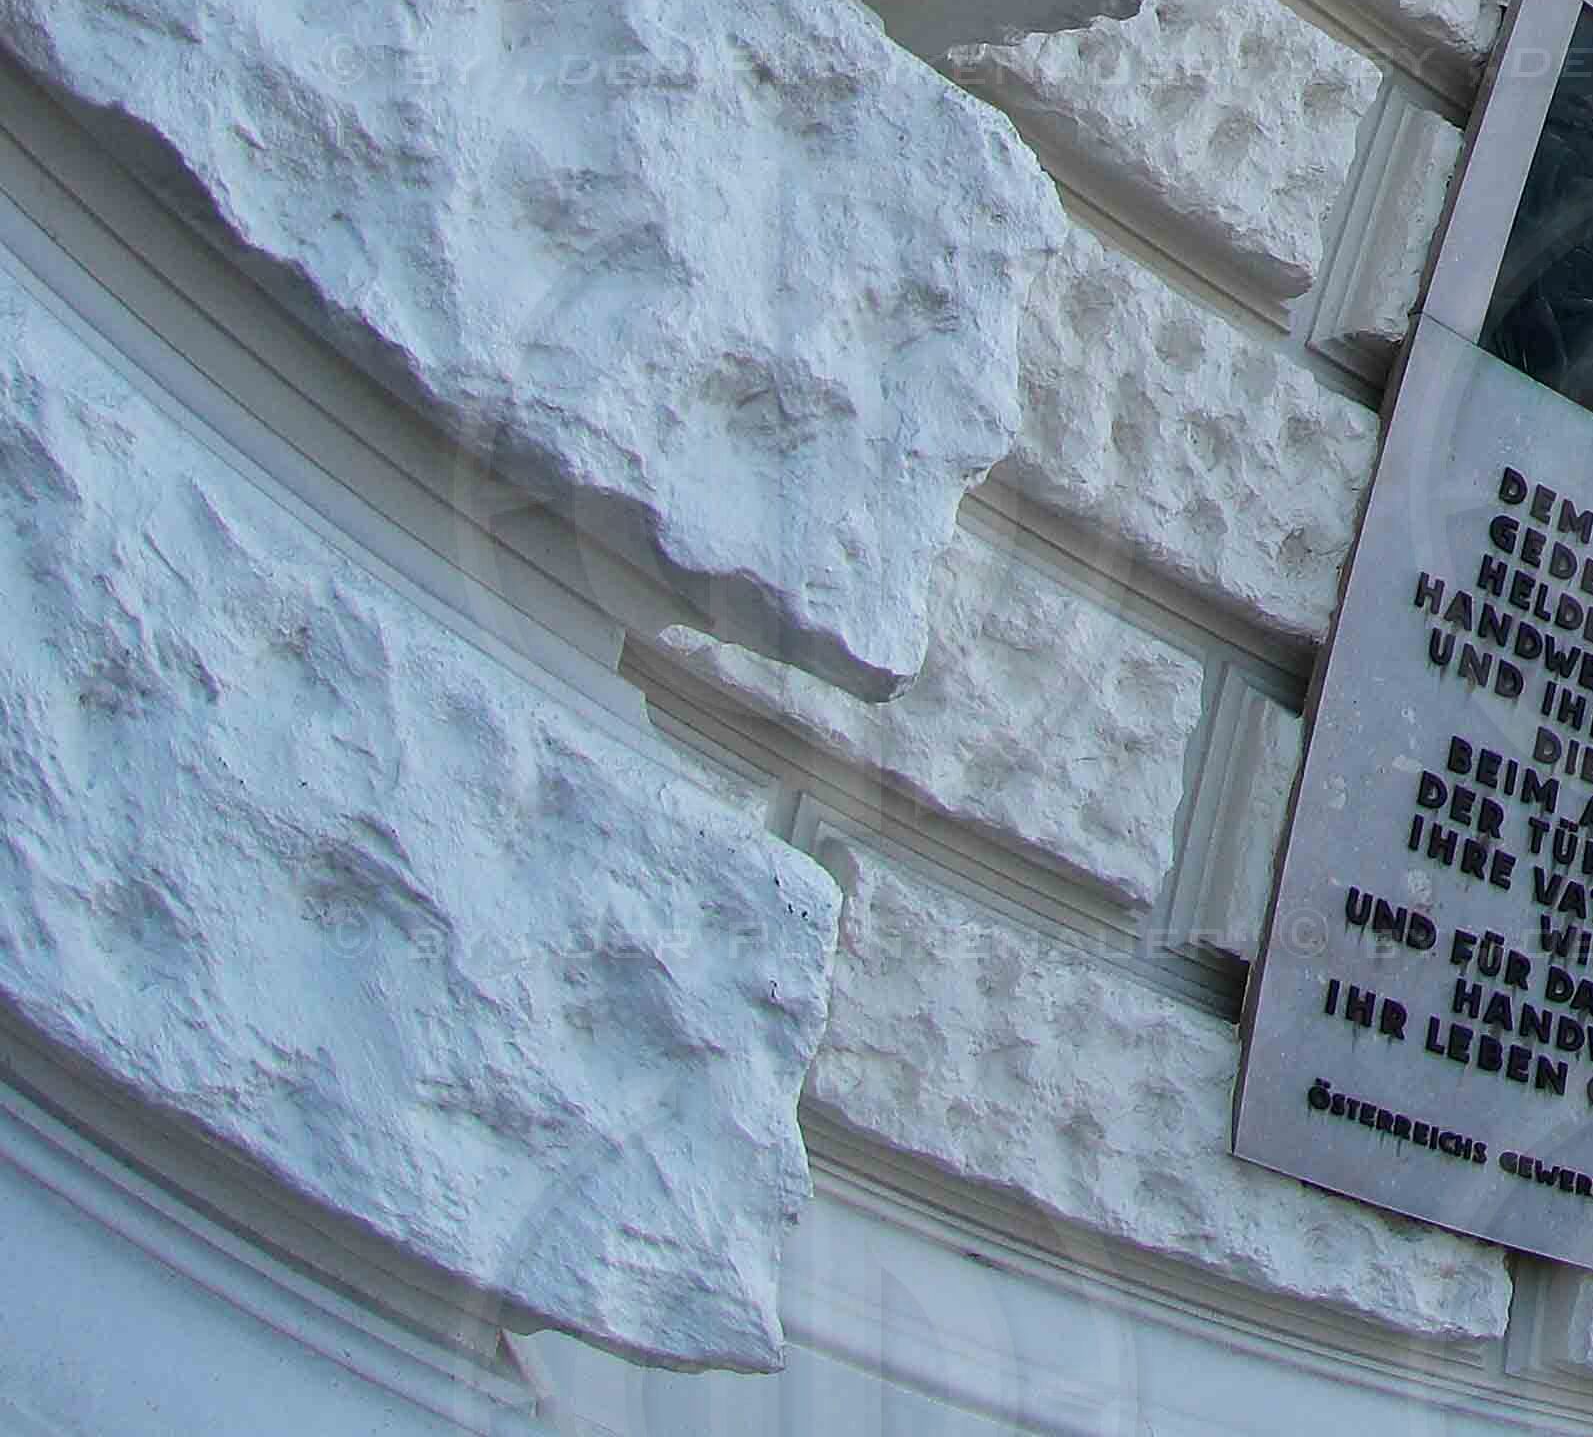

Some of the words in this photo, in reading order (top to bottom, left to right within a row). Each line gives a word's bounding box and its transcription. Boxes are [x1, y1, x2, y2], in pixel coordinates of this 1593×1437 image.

[1429, 627, 1525, 699] UND
[1416, 770, 1506, 840] DER
[1446, 734, 1560, 815] BEIM
[1406, 813, 1519, 891] IHRE
[1344, 886, 1439, 952] UND
[1450, 927, 1534, 992] FÜR
[1323, 978, 1409, 1042] IHR
[1425, 1014, 1570, 1098] LEBEN
[1307, 1076, 1489, 1165] ÖSTERREICHS
